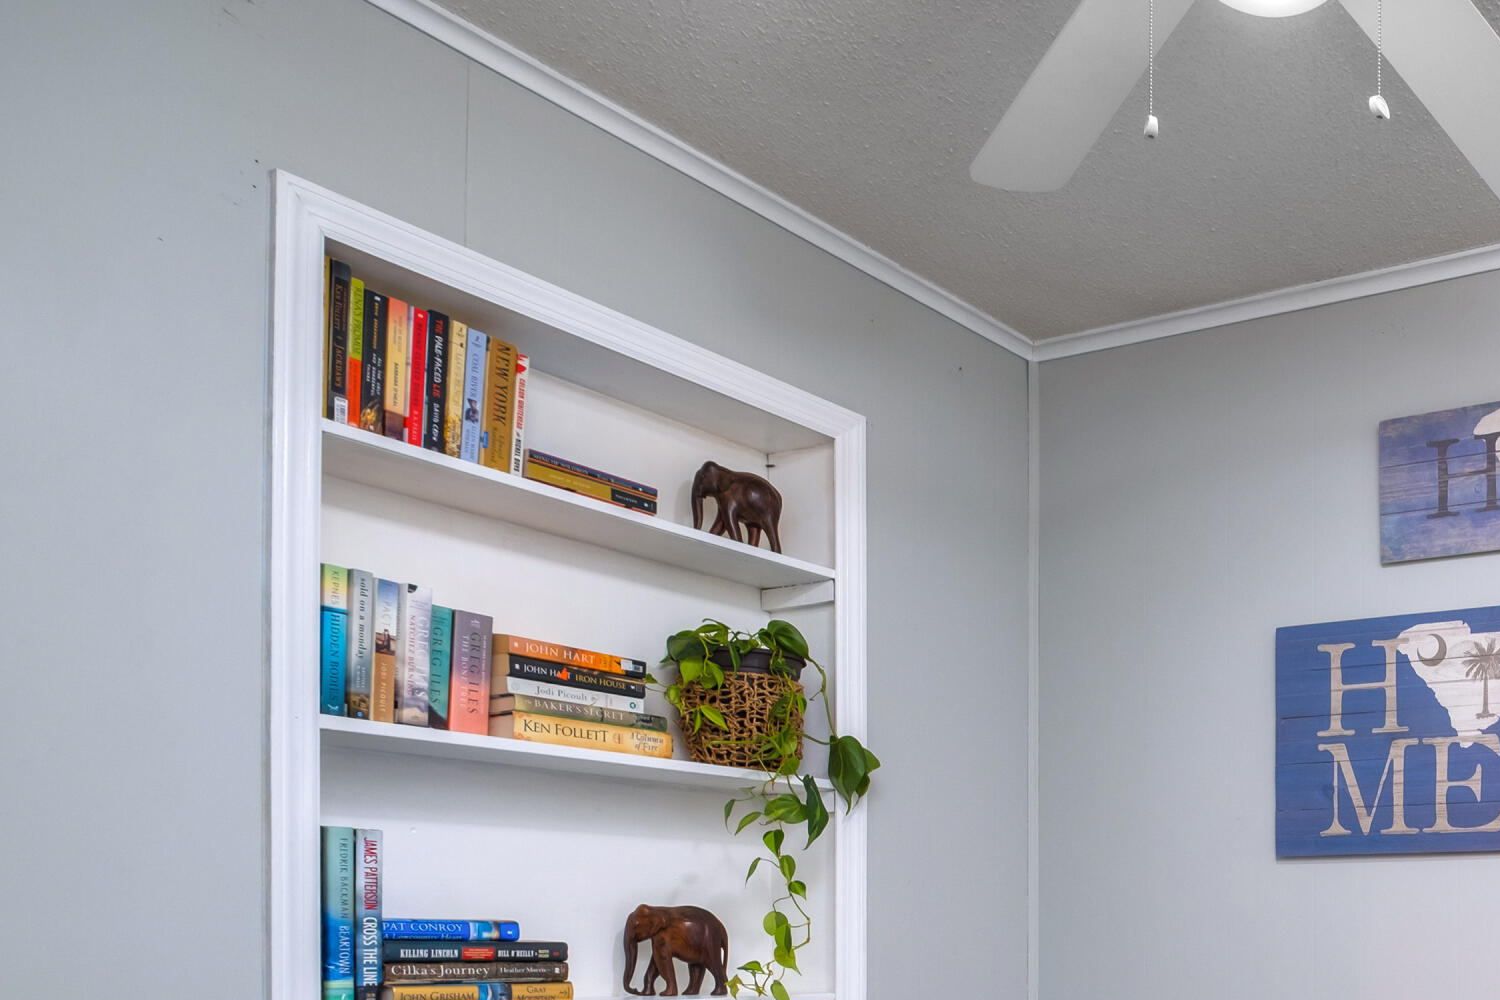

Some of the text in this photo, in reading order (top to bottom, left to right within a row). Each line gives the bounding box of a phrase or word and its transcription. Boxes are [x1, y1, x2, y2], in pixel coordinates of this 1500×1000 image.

[495, 344, 511, 381] NEW
[492, 385, 508, 426] YORK
[360, 578, 369, 597] sold
[330, 614, 341, 659] HIDDEN
[356, 624, 368, 659] monday
[526, 642, 597, 665] JOHN HART
[431, 627, 442, 705] GREG ILES
[467, 632, 481, 714] GREG ILES
[523, 663, 548, 676] JOHN
[575, 674, 598, 685] IRON
[599, 677, 627, 690] HOUSE
[535, 686, 588, 702] Jodi Picoult
[534, 698, 625, 721] BAKER'S SECRET
[523, 719, 608, 743] KEN FOLLETT
[363, 837, 378, 910] JAMES PATTERSON
[363, 917, 378, 945] CROSS
[382, 922, 463, 932] PAT CONROY
[339, 925, 350, 974] BEARTOWN
[363, 947, 377, 964] THE
[400, 949, 429, 958] KILLING
[431, 949, 459, 958] LINCOLN
[363, 966, 378, 987] LINE
[391, 965, 490, 977] Cilka's Journey
[429, 992, 475, 1000] GRISHAM
